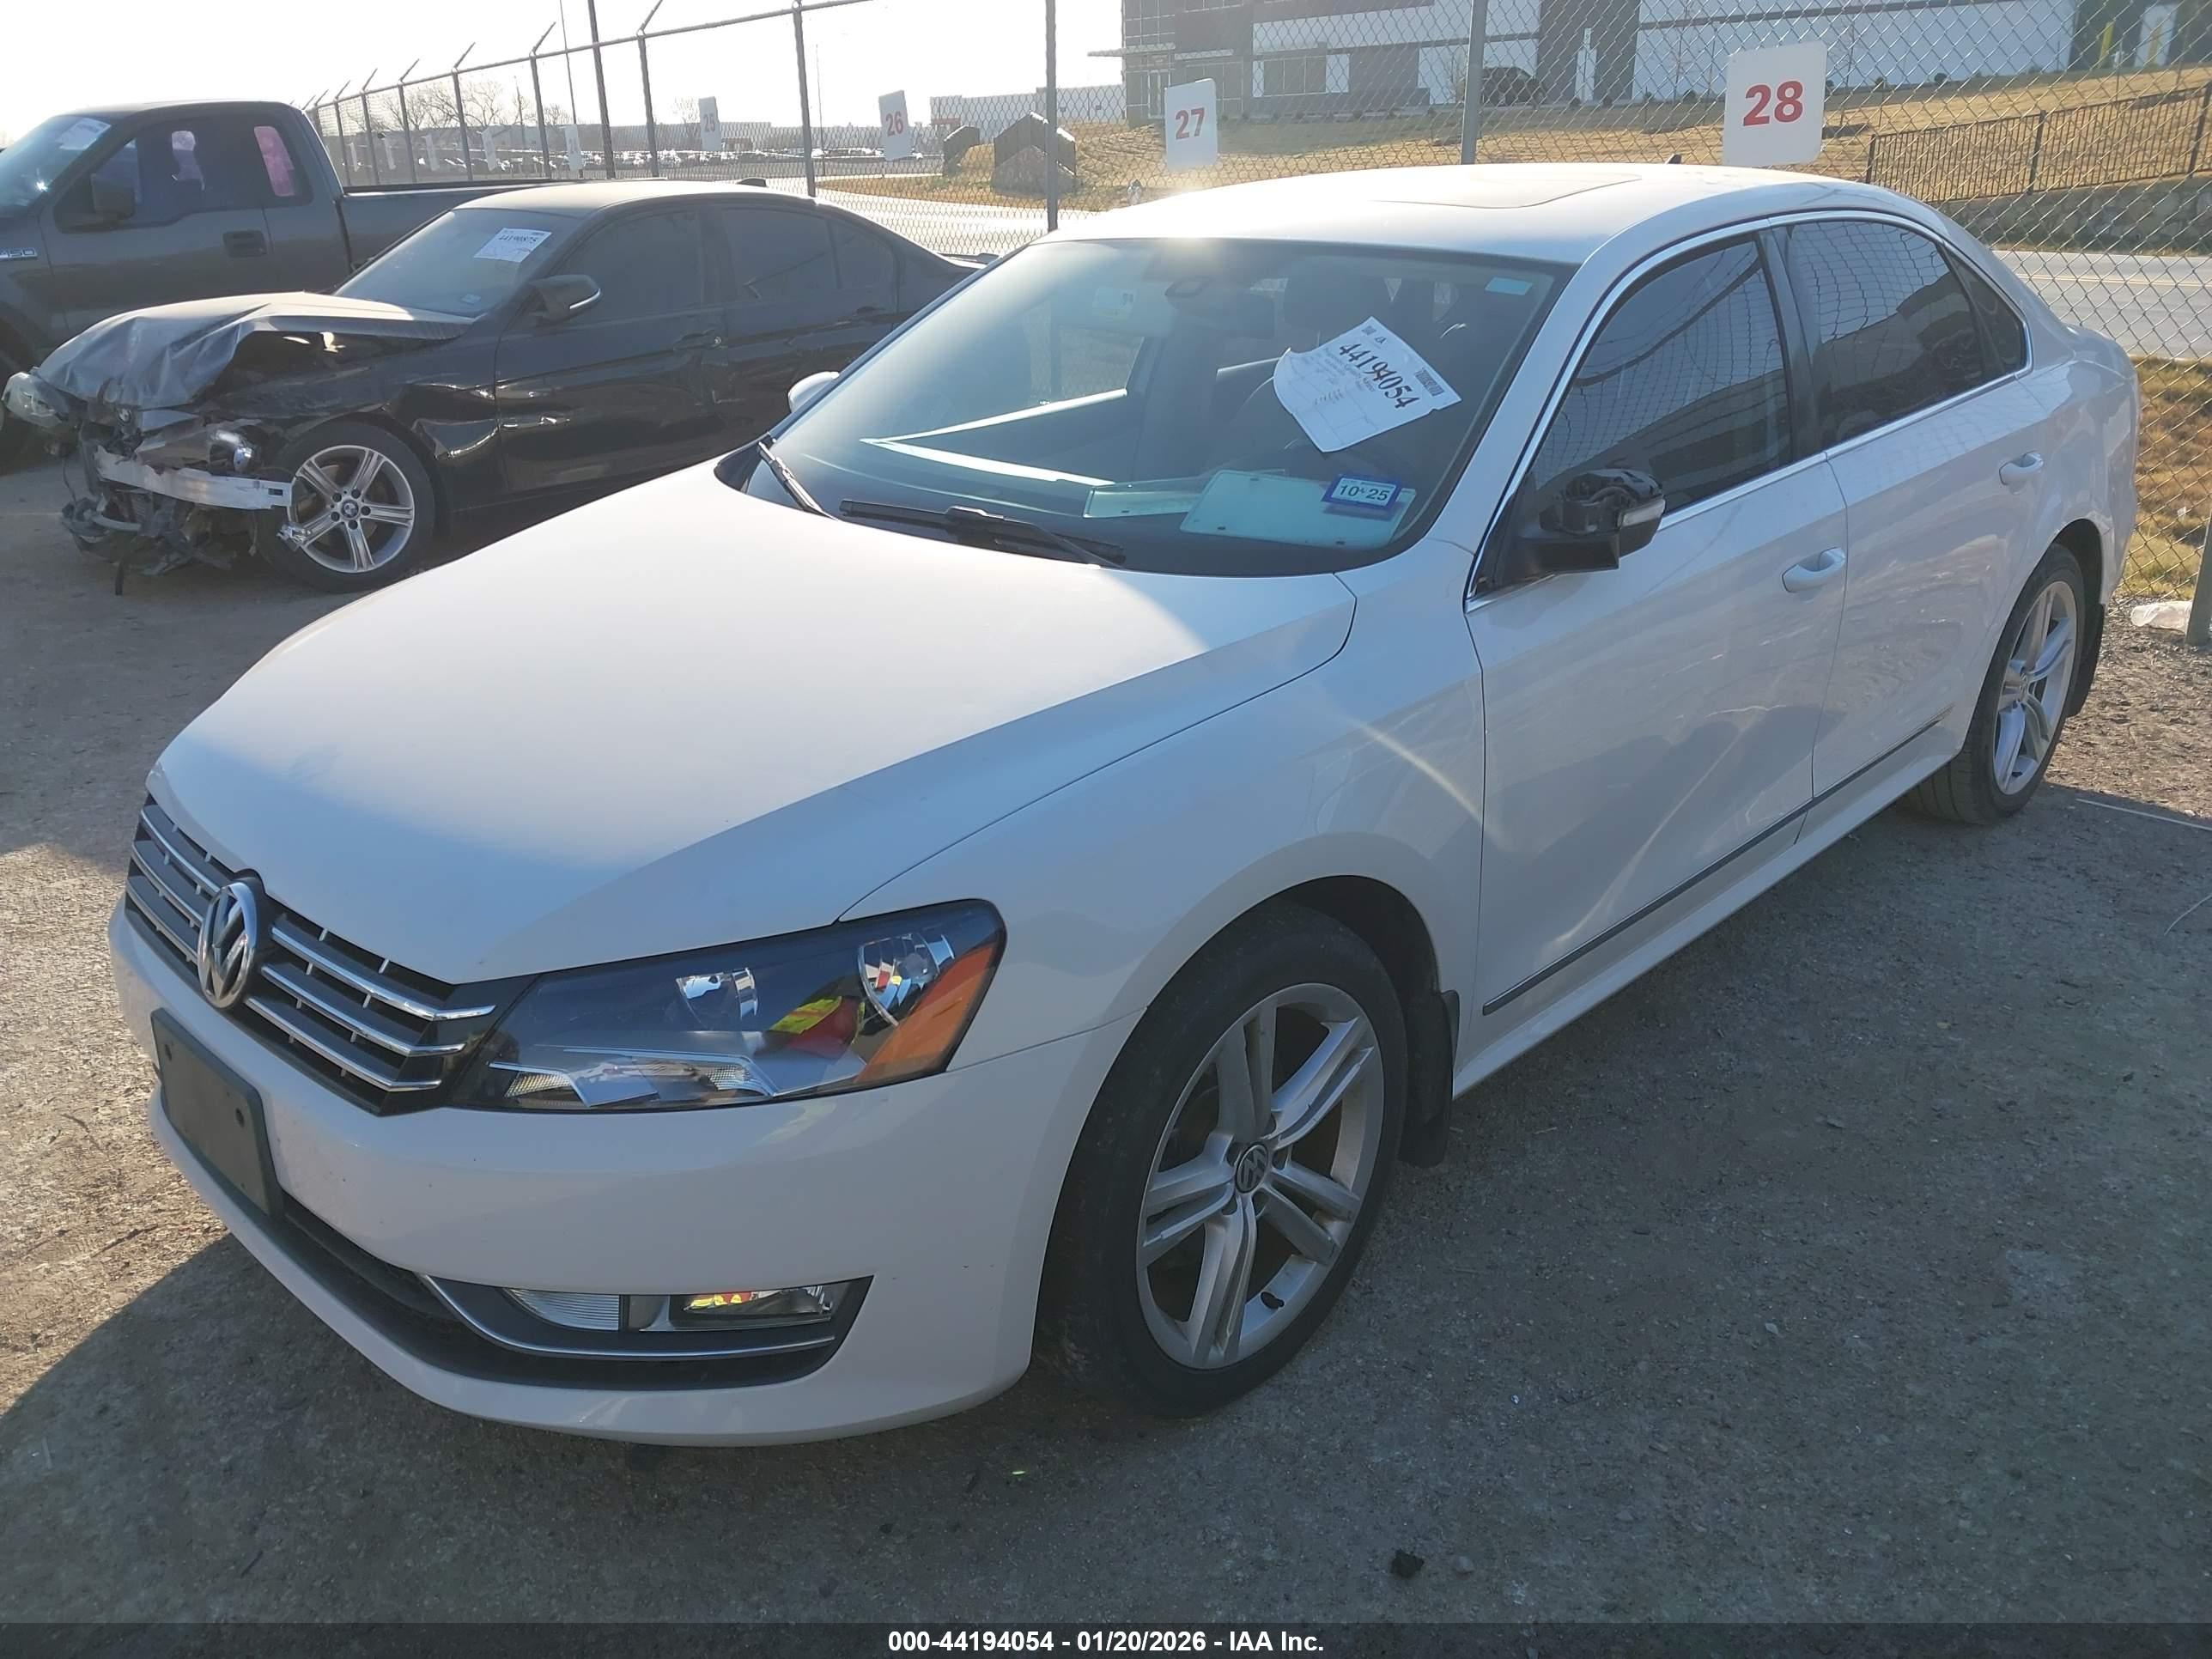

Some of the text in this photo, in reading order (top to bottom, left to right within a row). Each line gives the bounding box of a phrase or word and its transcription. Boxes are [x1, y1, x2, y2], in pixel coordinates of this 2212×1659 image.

[1742, 80, 1804, 127] 28
[703, 112, 716, 133] 25
[885, 110, 902, 137] 26
[1175, 107, 1205, 140] 27
[1339, 343, 1420, 410] 44194054
[1340, 484, 1360, 497] 10
[1365, 488, 1390, 501] 25
